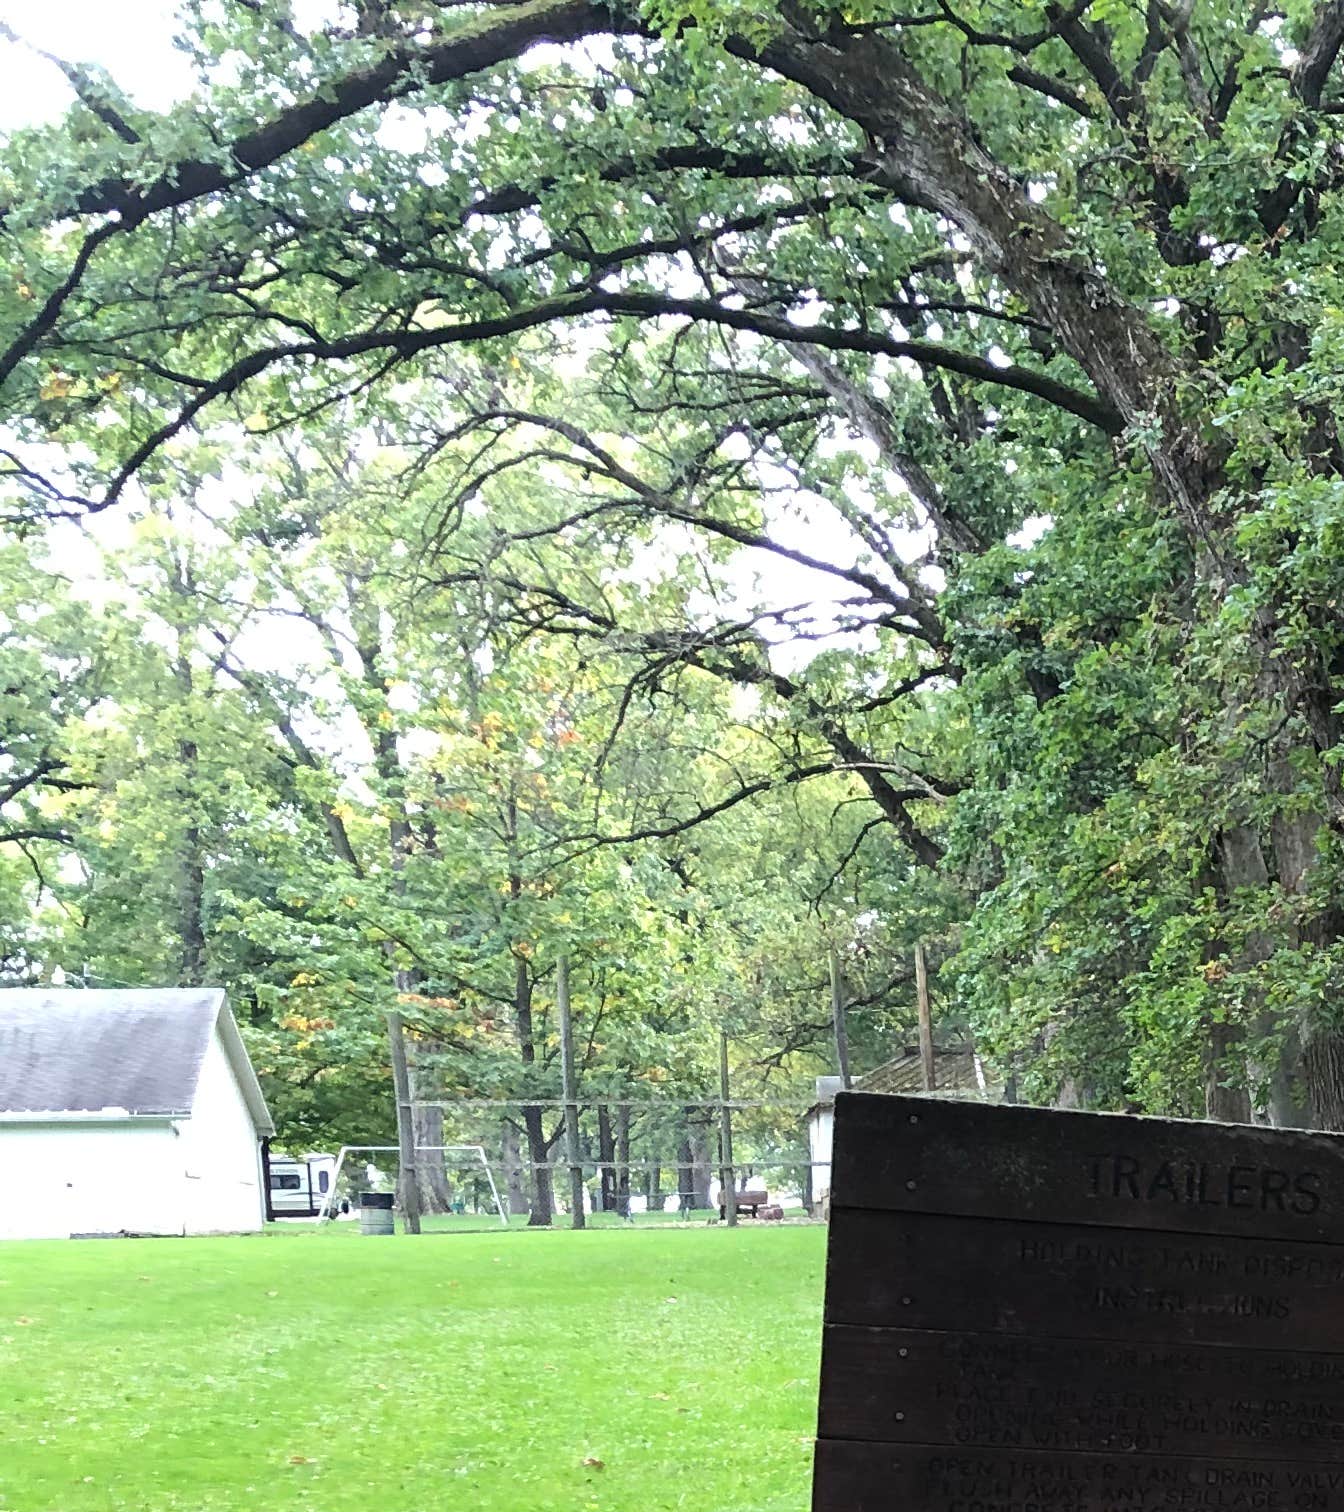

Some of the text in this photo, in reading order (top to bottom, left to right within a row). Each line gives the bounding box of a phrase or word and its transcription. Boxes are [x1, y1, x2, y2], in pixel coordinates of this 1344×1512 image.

[1087, 1153, 1321, 1216] TRAILERS
[1092, 1286, 1291, 1320] INSTRUIONS
[929, 1456, 995, 1477] OPEN
[1008, 1460, 1118, 1481] TRAILER
[1204, 1468, 1274, 1488] DRAIN
[1026, 1482, 1086, 1499] AWAY
[1102, 1486, 1151, 1502] ANY
[1165, 1488, 1281, 1507] SPILLAGE
